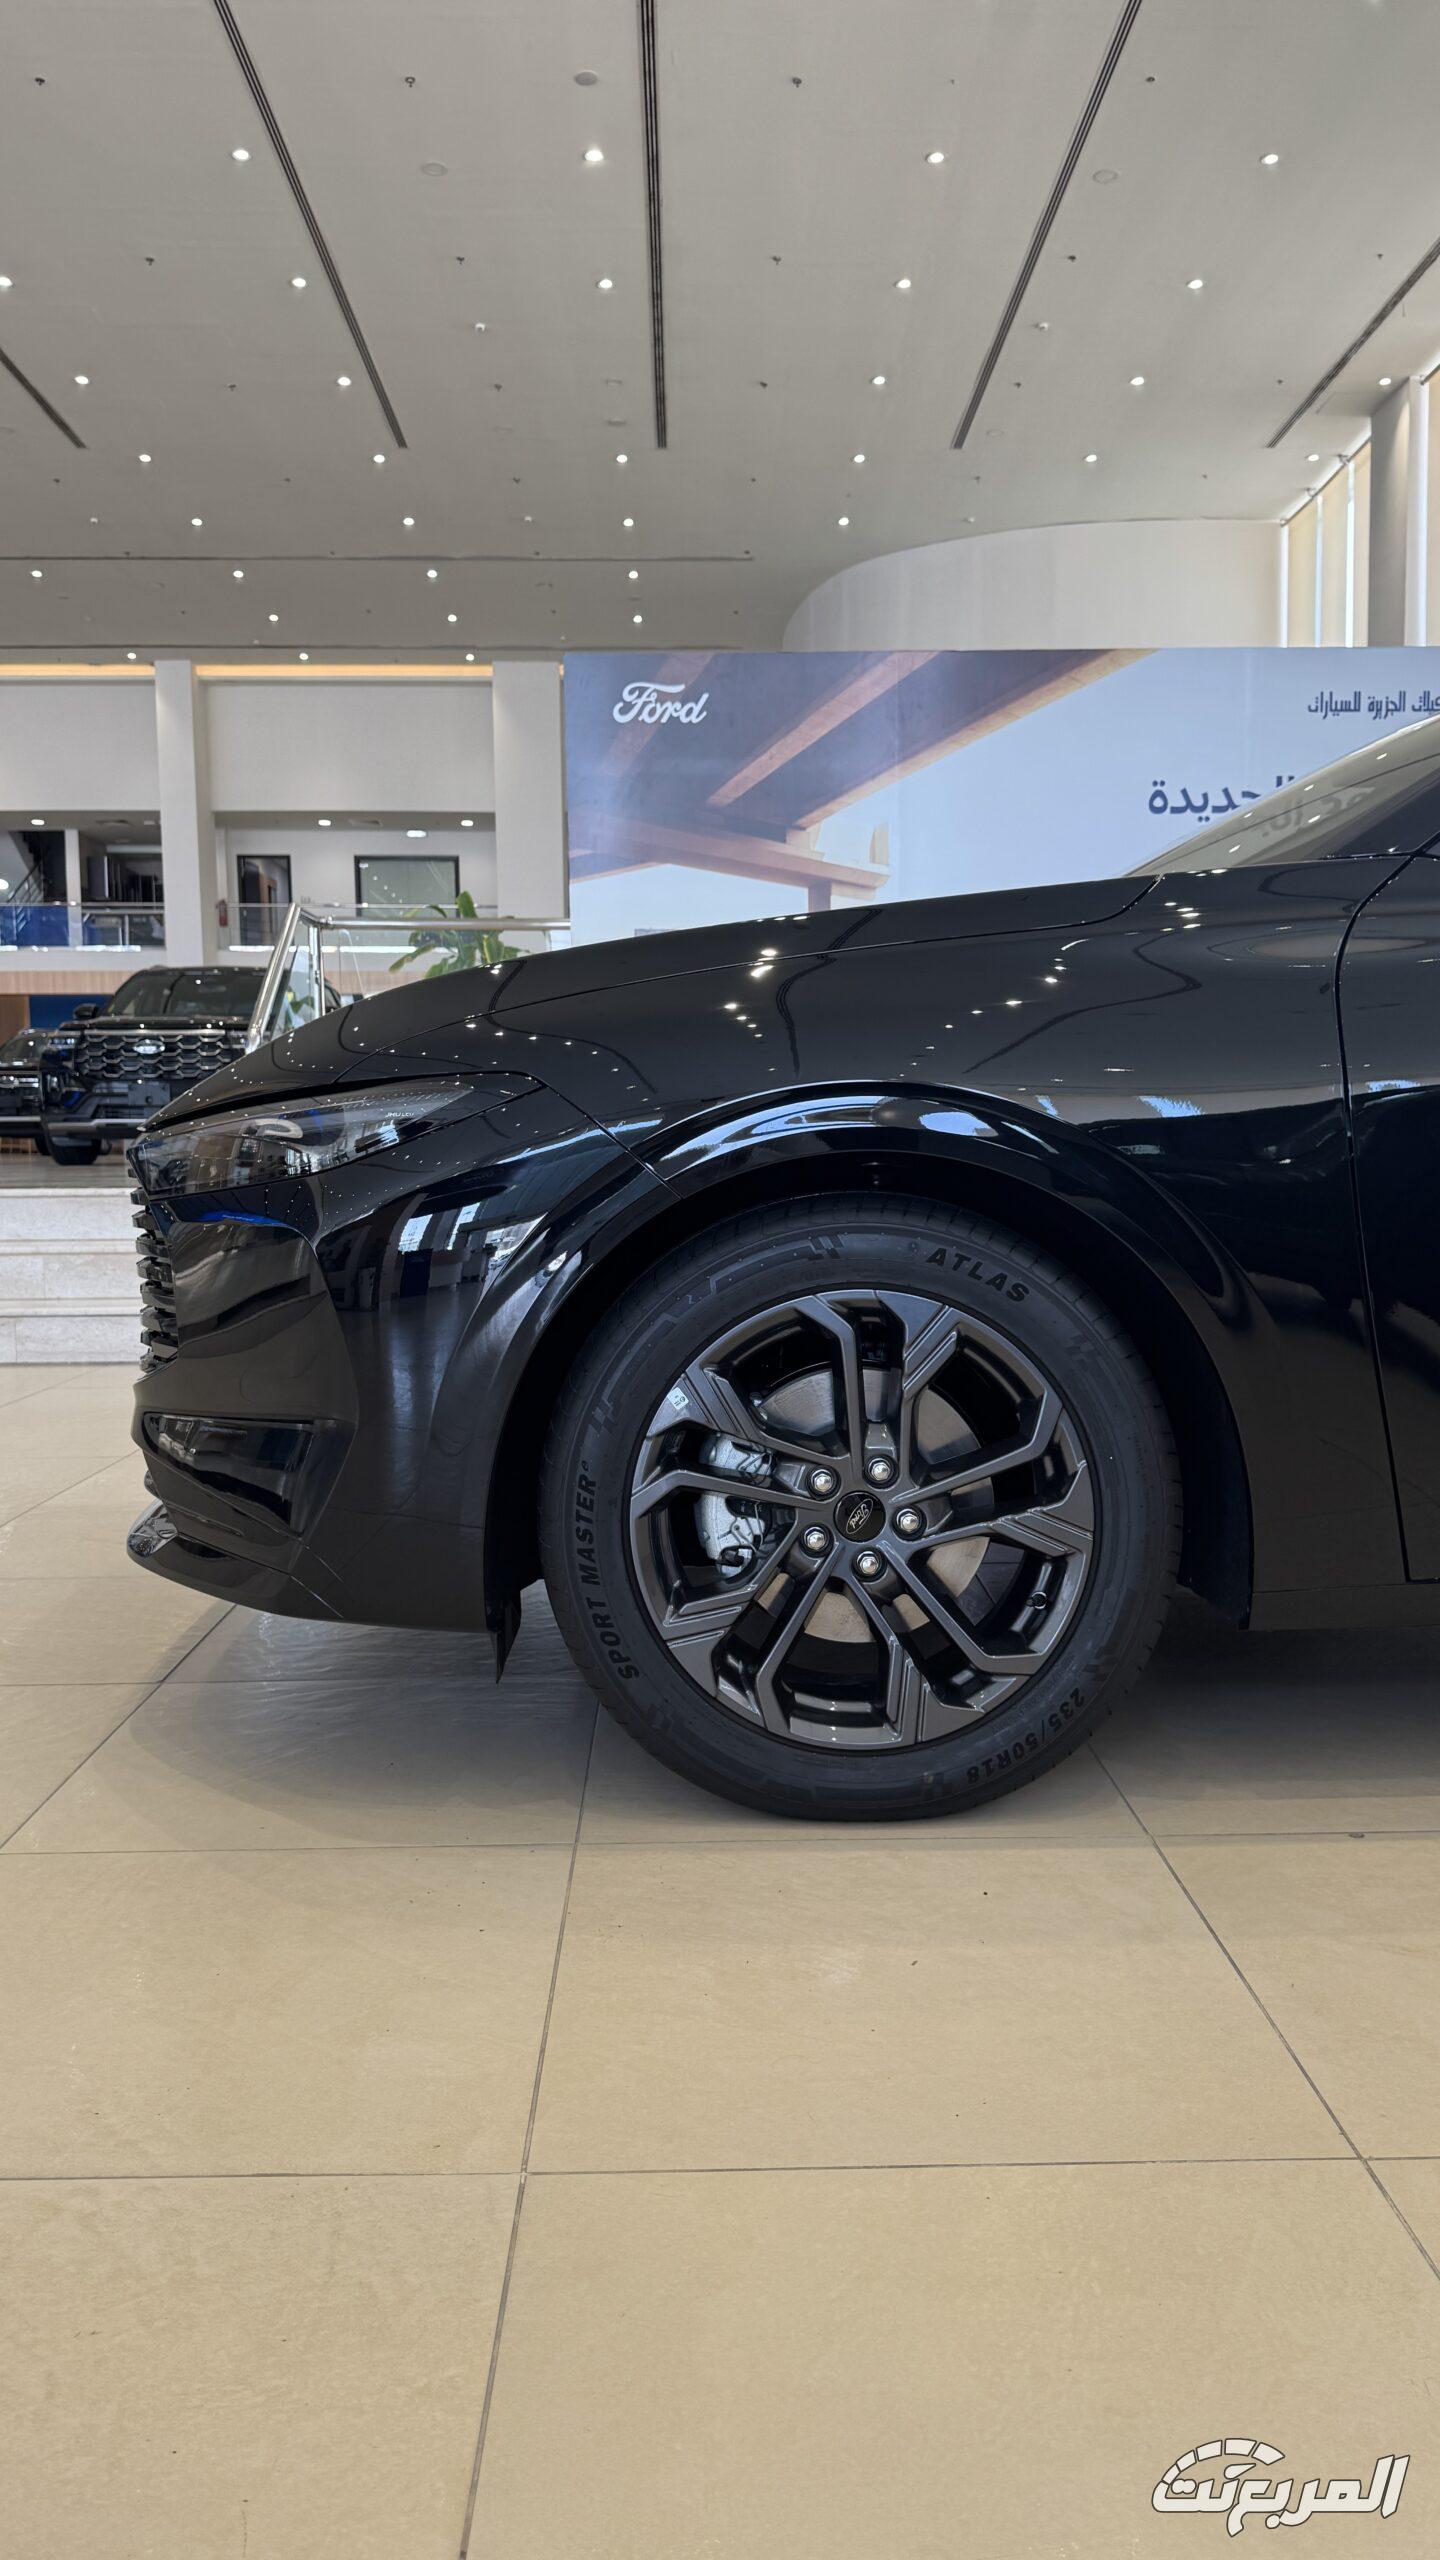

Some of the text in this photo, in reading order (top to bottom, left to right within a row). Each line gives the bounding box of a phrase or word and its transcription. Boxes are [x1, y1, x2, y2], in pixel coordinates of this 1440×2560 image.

[613, 681, 709, 723] Ford
[1307, 691, 1361, 720] للسيارات
[1367, 690, 1406, 720] الجزيرة
[1149, 775, 1295, 823] ديدة
[926, 1247, 1030, 1302] ATLAS
[586, 1597, 640, 1680] SPORT
[966, 1687, 1085, 1784] 235/50R18
